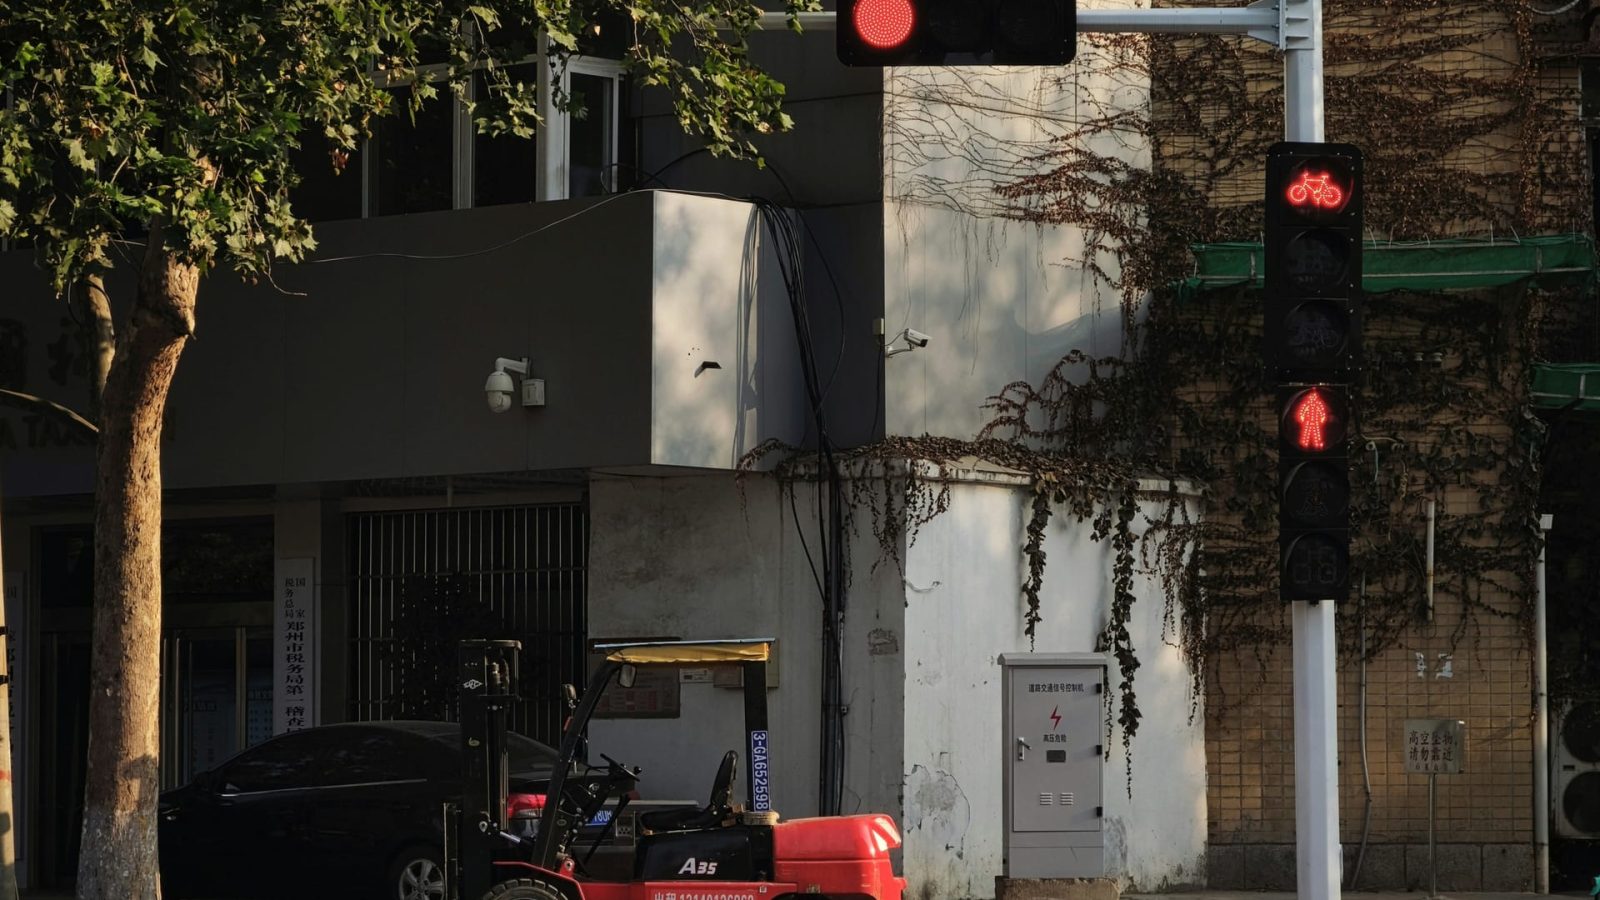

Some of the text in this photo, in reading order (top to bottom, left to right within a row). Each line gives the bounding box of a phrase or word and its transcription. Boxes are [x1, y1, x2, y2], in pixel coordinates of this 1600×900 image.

[1028, 683, 1085, 693] 道路交通信号控制机
[1043, 733, 1067, 743] 高压危险
[1409, 730, 1453, 745] 高空坠物
[1409, 746, 1454, 761] 请勿靠近
[753, 733, 769, 810] 3-GA652598
[678, 857, 719, 875] A35
